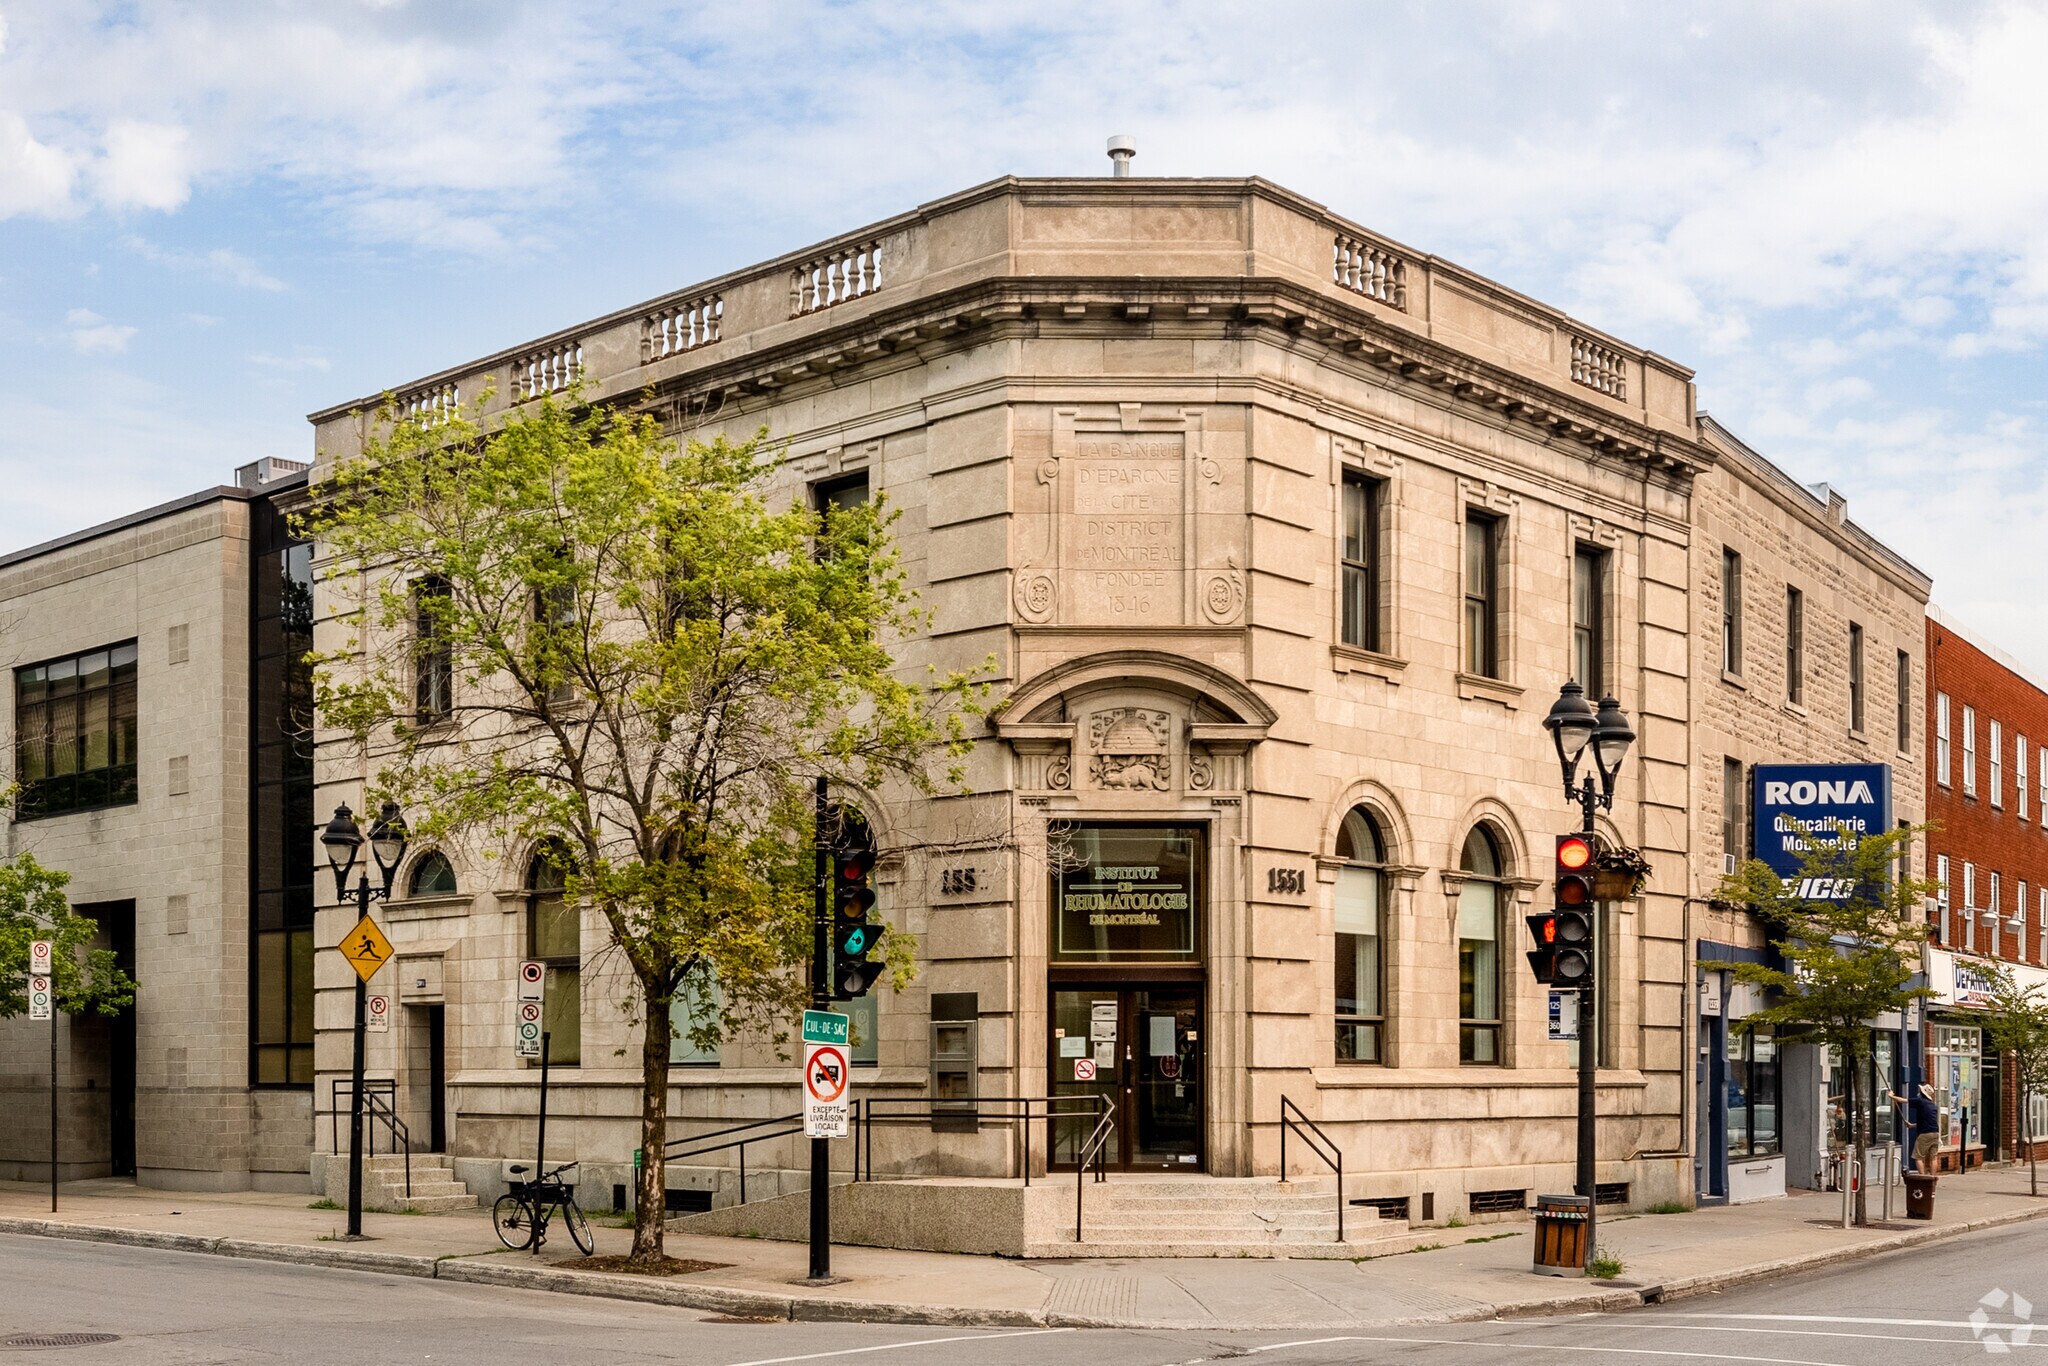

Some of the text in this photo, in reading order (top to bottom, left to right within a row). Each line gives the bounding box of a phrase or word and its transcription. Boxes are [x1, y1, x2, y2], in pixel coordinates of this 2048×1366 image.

[1078, 442, 1181, 457] LA BANQUE
[1087, 520, 1171, 536] DISTRICT
[1077, 543, 1182, 562] DE MONTRÉAL
[1109, 594, 1150, 617] 1846
[1765, 780, 1875, 805] RONA
[1782, 835, 1857, 851] Mousette
[1094, 866, 1159, 880] INSTITUT
[1268, 867, 1306, 894] 1551
[1117, 882, 1133, 892] DE
[1065, 893, 1188, 911] RHUMATOLOGIE
[1089, 912, 1160, 926] DE MONTRÉAL
[1549, 1001, 1561, 1010] 125
[805, 1019, 846, 1037] CUL-DE-SAC
[1549, 1021, 1561, 1030] 360
[812, 1105, 840, 1114] EXCEPTÉ
[810, 1114, 843, 1122] LIVRAISON
[815, 1122, 838, 1131] LOCALE
